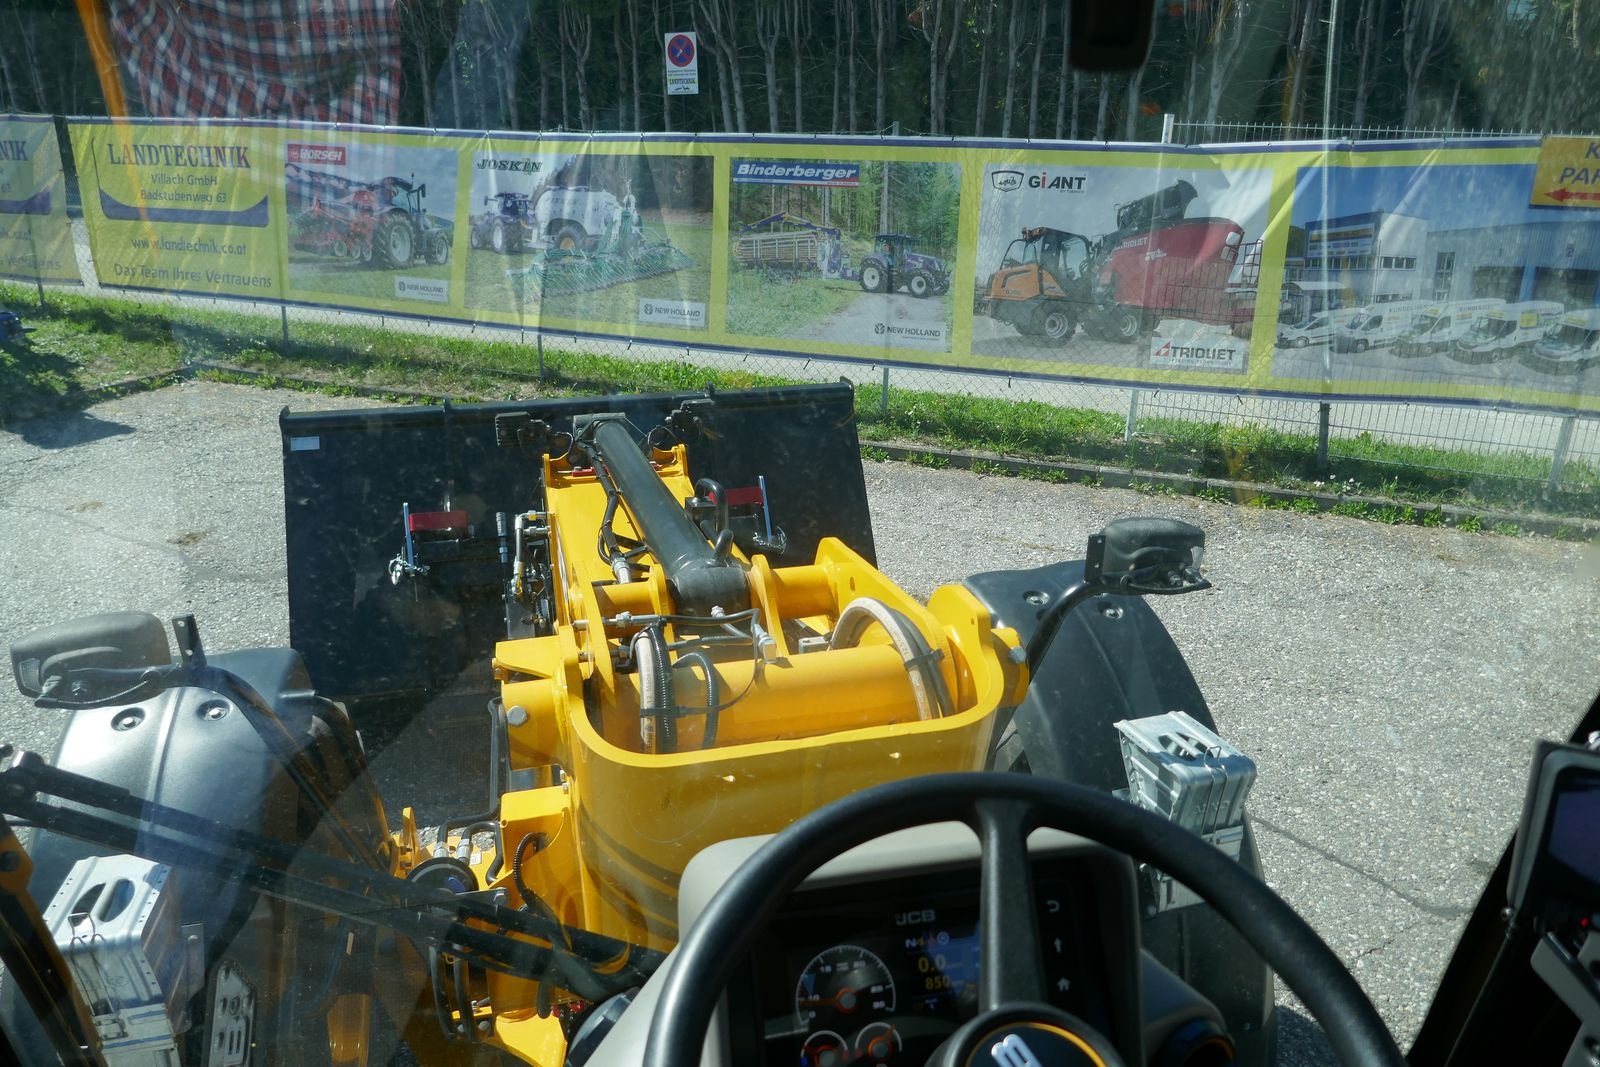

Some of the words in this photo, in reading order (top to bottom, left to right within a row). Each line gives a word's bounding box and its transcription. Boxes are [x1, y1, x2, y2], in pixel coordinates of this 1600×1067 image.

[107, 143, 251, 168] LANDTECHNIK
[300, 148, 342, 161] HORSCH
[477, 158, 543, 173] JOSKIN
[737, 163, 856, 180] Binderberger
[151, 173, 184, 186] Villach
[187, 174, 218, 186] GmbH
[141, 189, 212, 205] Badstubenweg
[216, 192, 227, 203] 63
[132, 235, 247, 256] www.landtechnik.co.at
[114, 263, 136, 277] Das
[140, 264, 169, 280] Team
[173, 267, 200, 282] Ihres
[206, 270, 272, 288] Vertrauens
[654, 306, 670, 314] NEW
[671, 308, 701, 317] HOLLAND
[887, 326, 904, 334] NEW
[905, 327, 941, 337] HOLLAND
[895, 909, 936, 926] JCB
[918, 954, 946, 973] 0.0
[925, 975, 951, 990] 850
